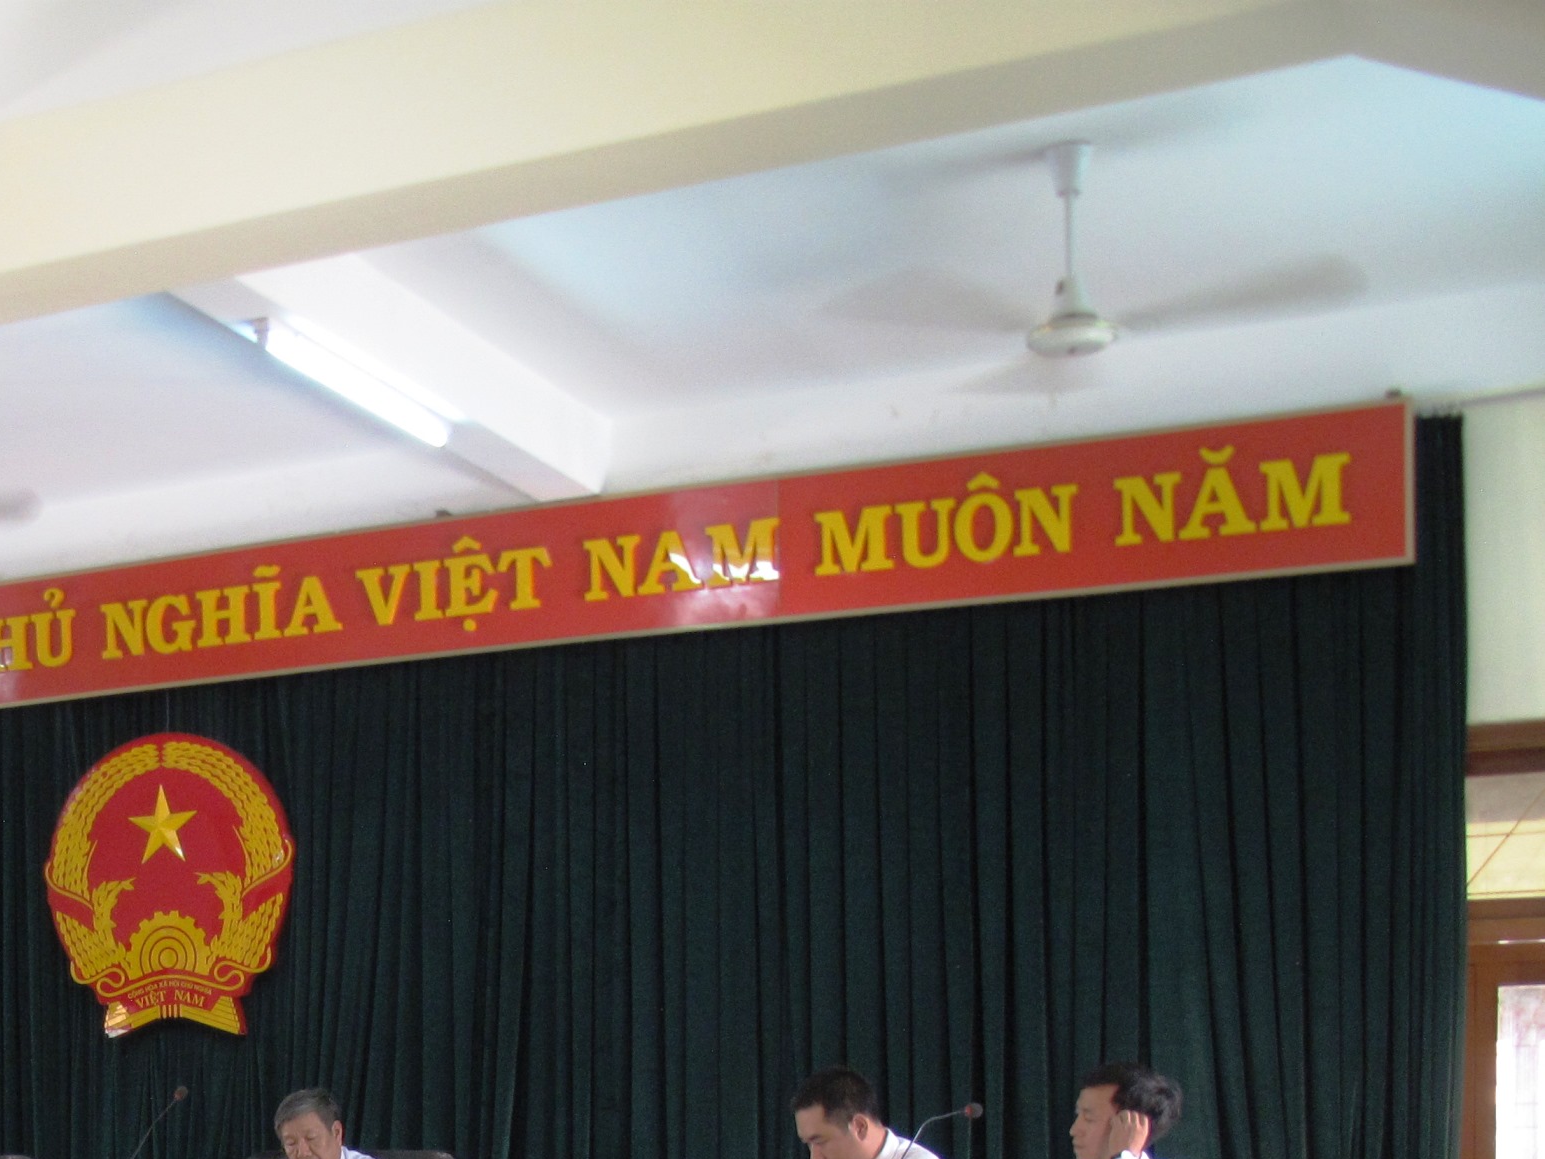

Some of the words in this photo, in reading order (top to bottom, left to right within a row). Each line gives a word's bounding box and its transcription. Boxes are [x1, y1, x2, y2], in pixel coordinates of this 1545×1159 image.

[101, 561, 342, 661] NGHĨA
[355, 535, 553, 632] VIỆT
[583, 517, 780, 602] NAM
[813, 472, 1080, 577] MUÔN
[1114, 444, 1352, 547] NĂM
[135, 990, 167, 1008] VIỆT
[174, 989, 206, 1007] NAM
